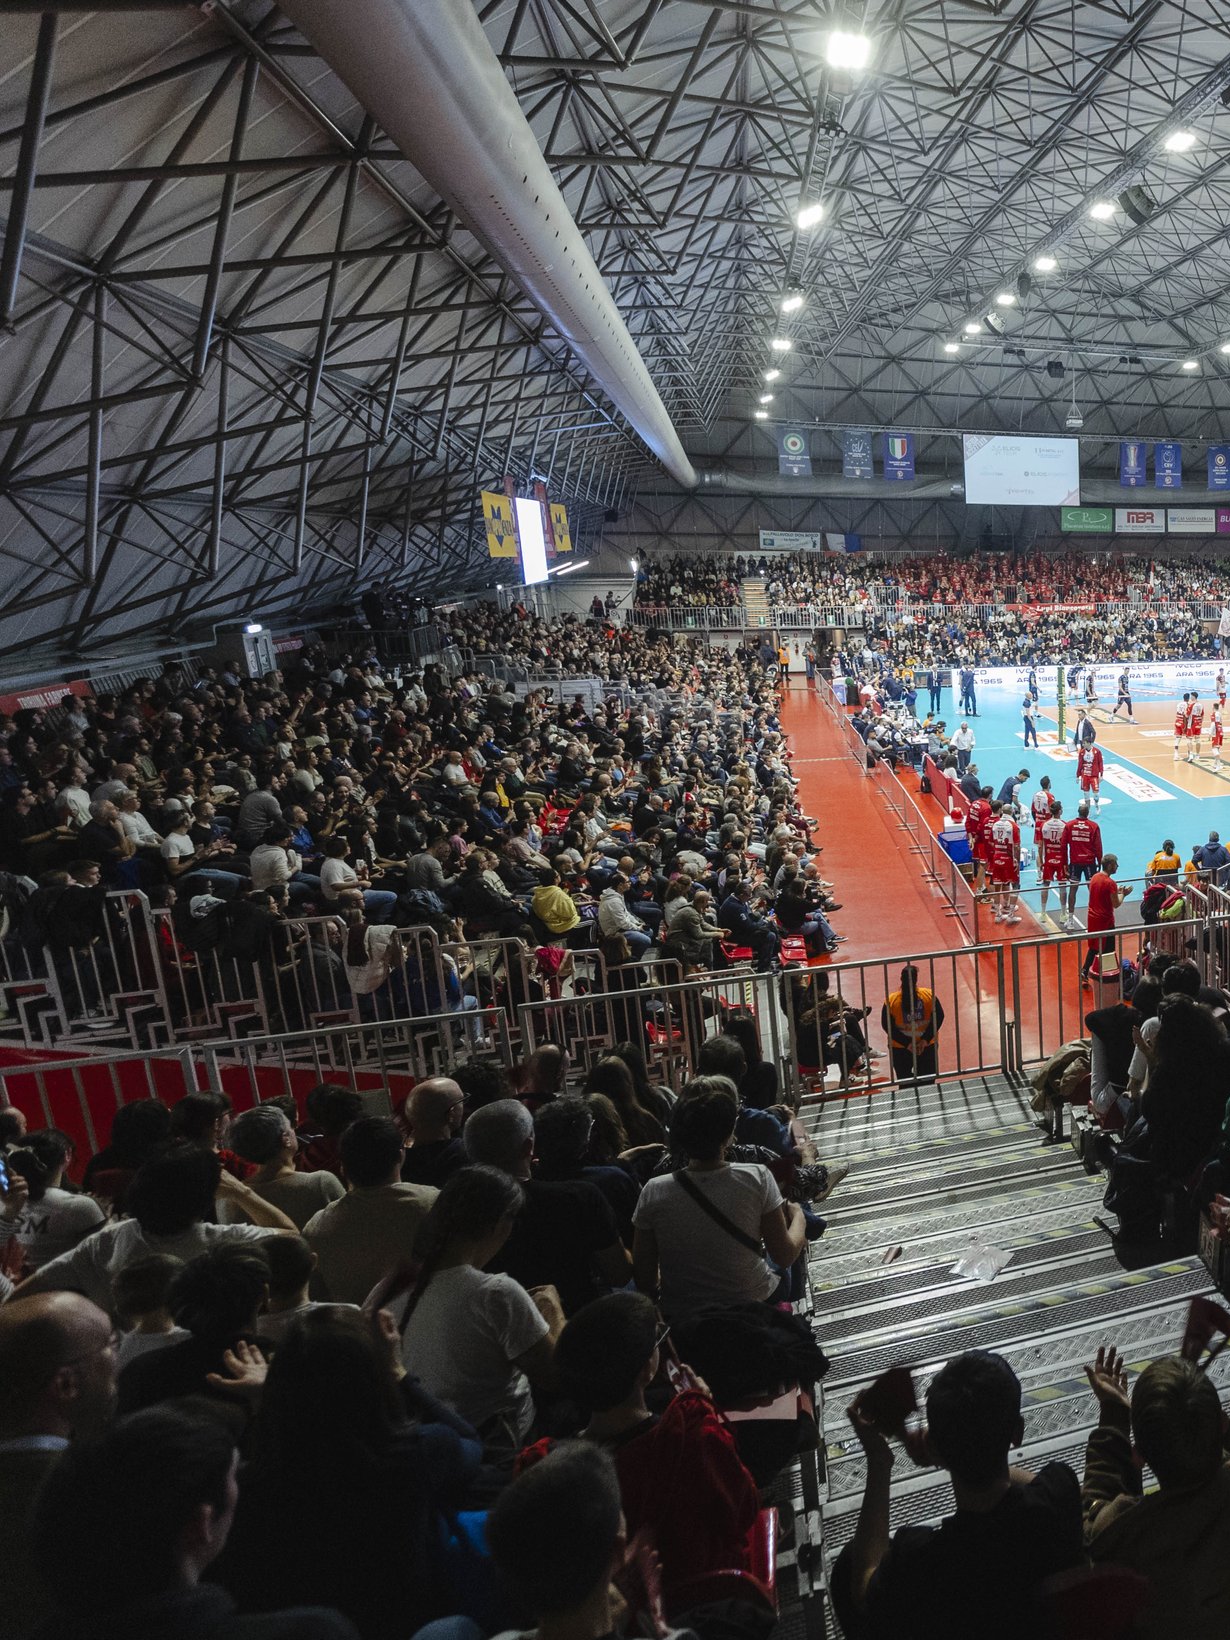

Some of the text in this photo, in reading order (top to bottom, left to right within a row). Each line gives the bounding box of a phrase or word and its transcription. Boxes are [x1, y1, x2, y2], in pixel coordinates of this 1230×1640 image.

[1126, 511, 1155, 524] MBR
[997, 830, 1004, 839] 12
[1051, 830, 1058, 839] 17
